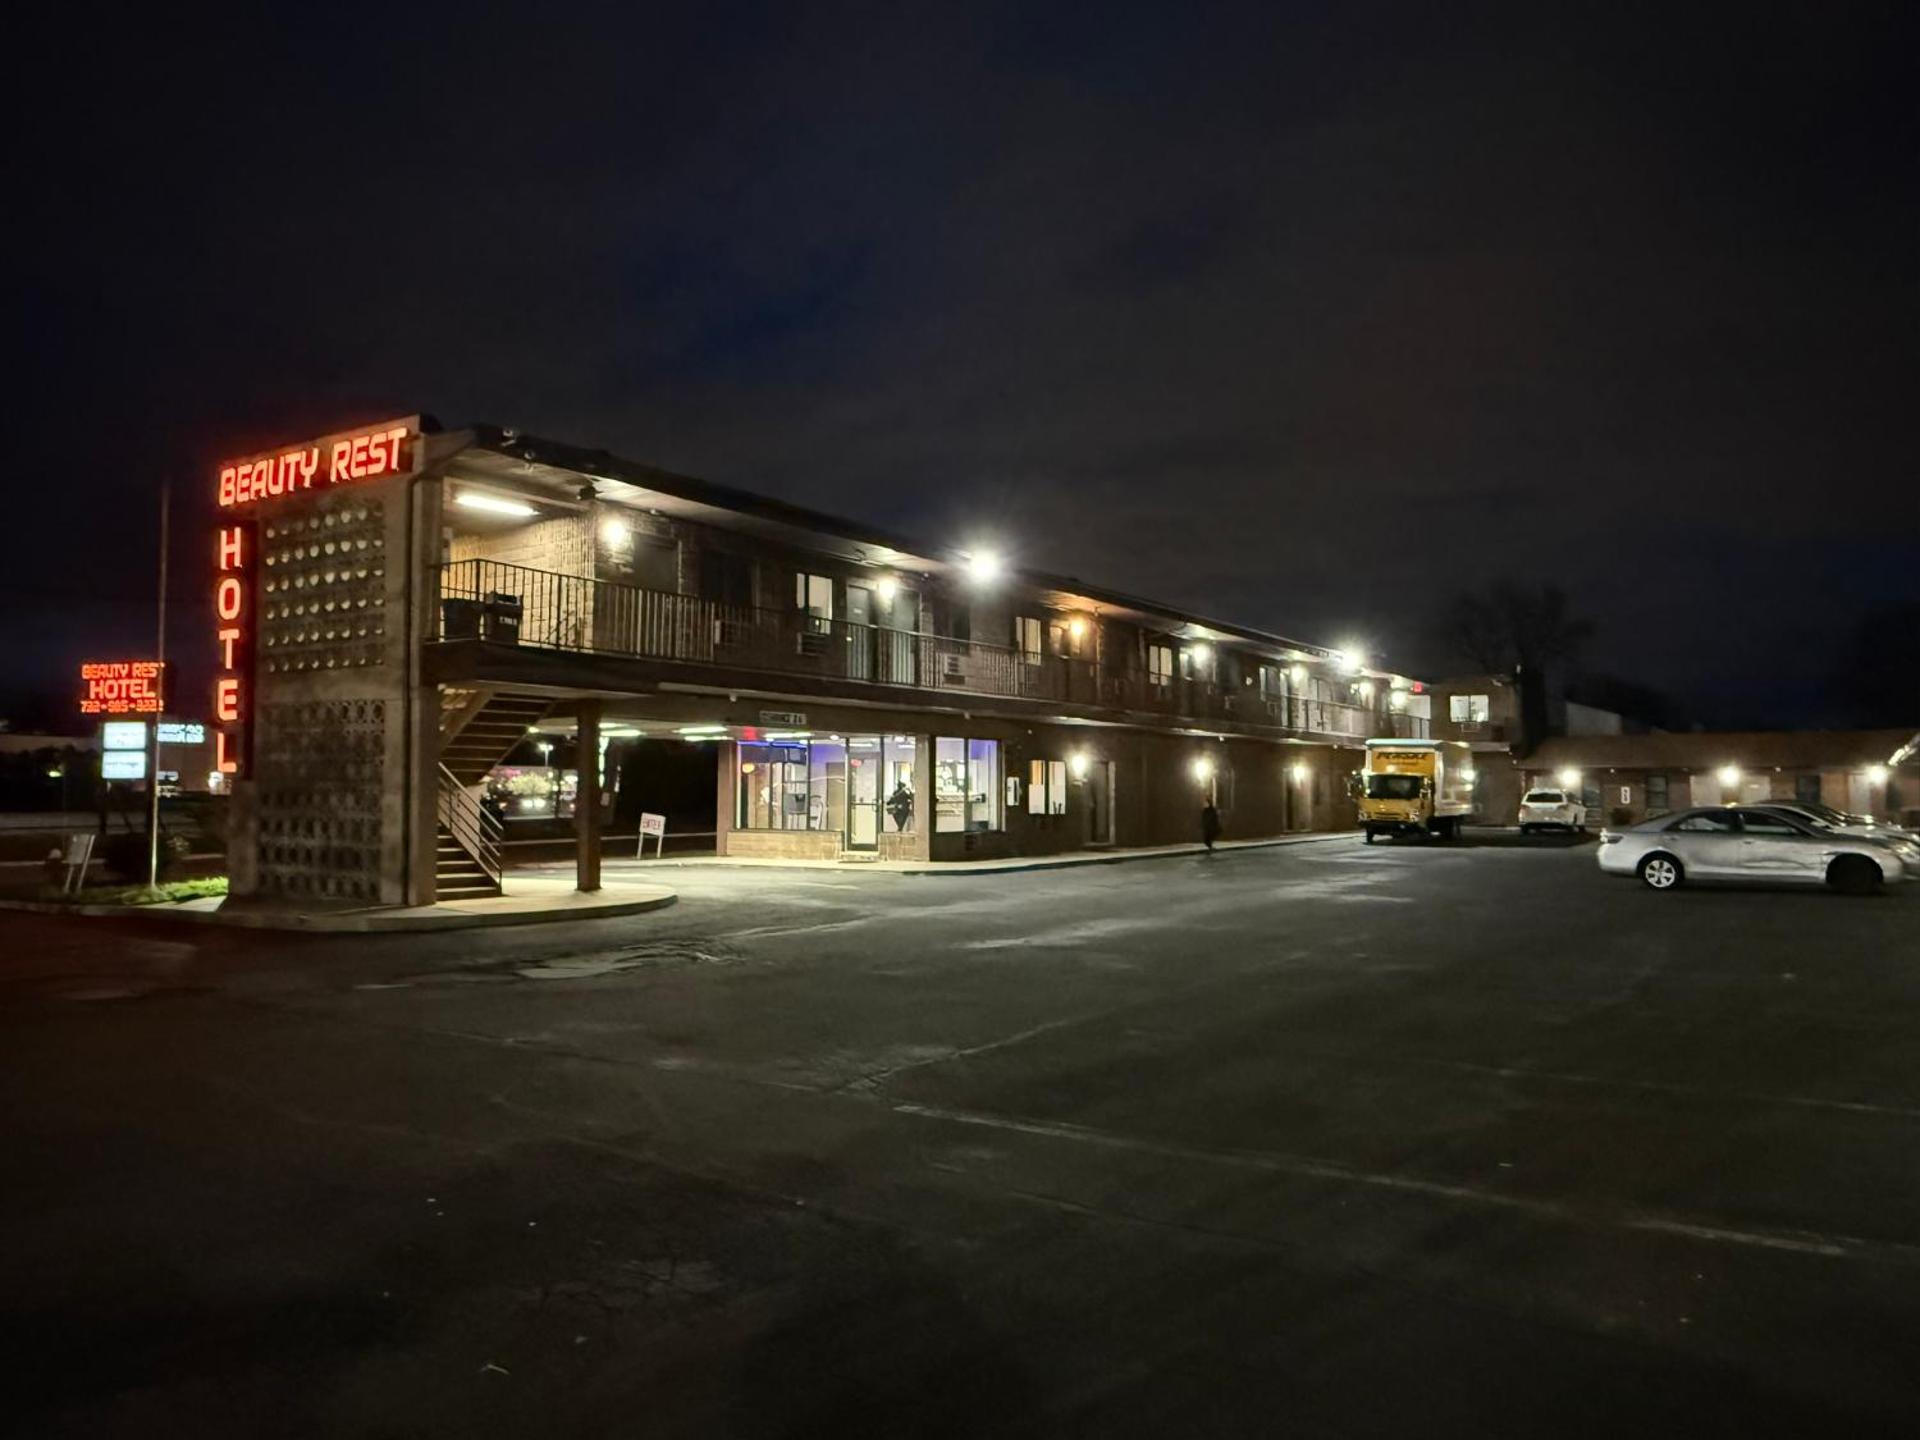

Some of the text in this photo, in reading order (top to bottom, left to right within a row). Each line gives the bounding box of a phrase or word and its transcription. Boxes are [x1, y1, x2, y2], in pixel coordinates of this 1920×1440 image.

[218, 426, 408, 507] BEAUTY REST
[82, 663, 129, 680] BEAUTY
[216, 526, 242, 774] HOTEL
[90, 678, 157, 700] HOTEL
